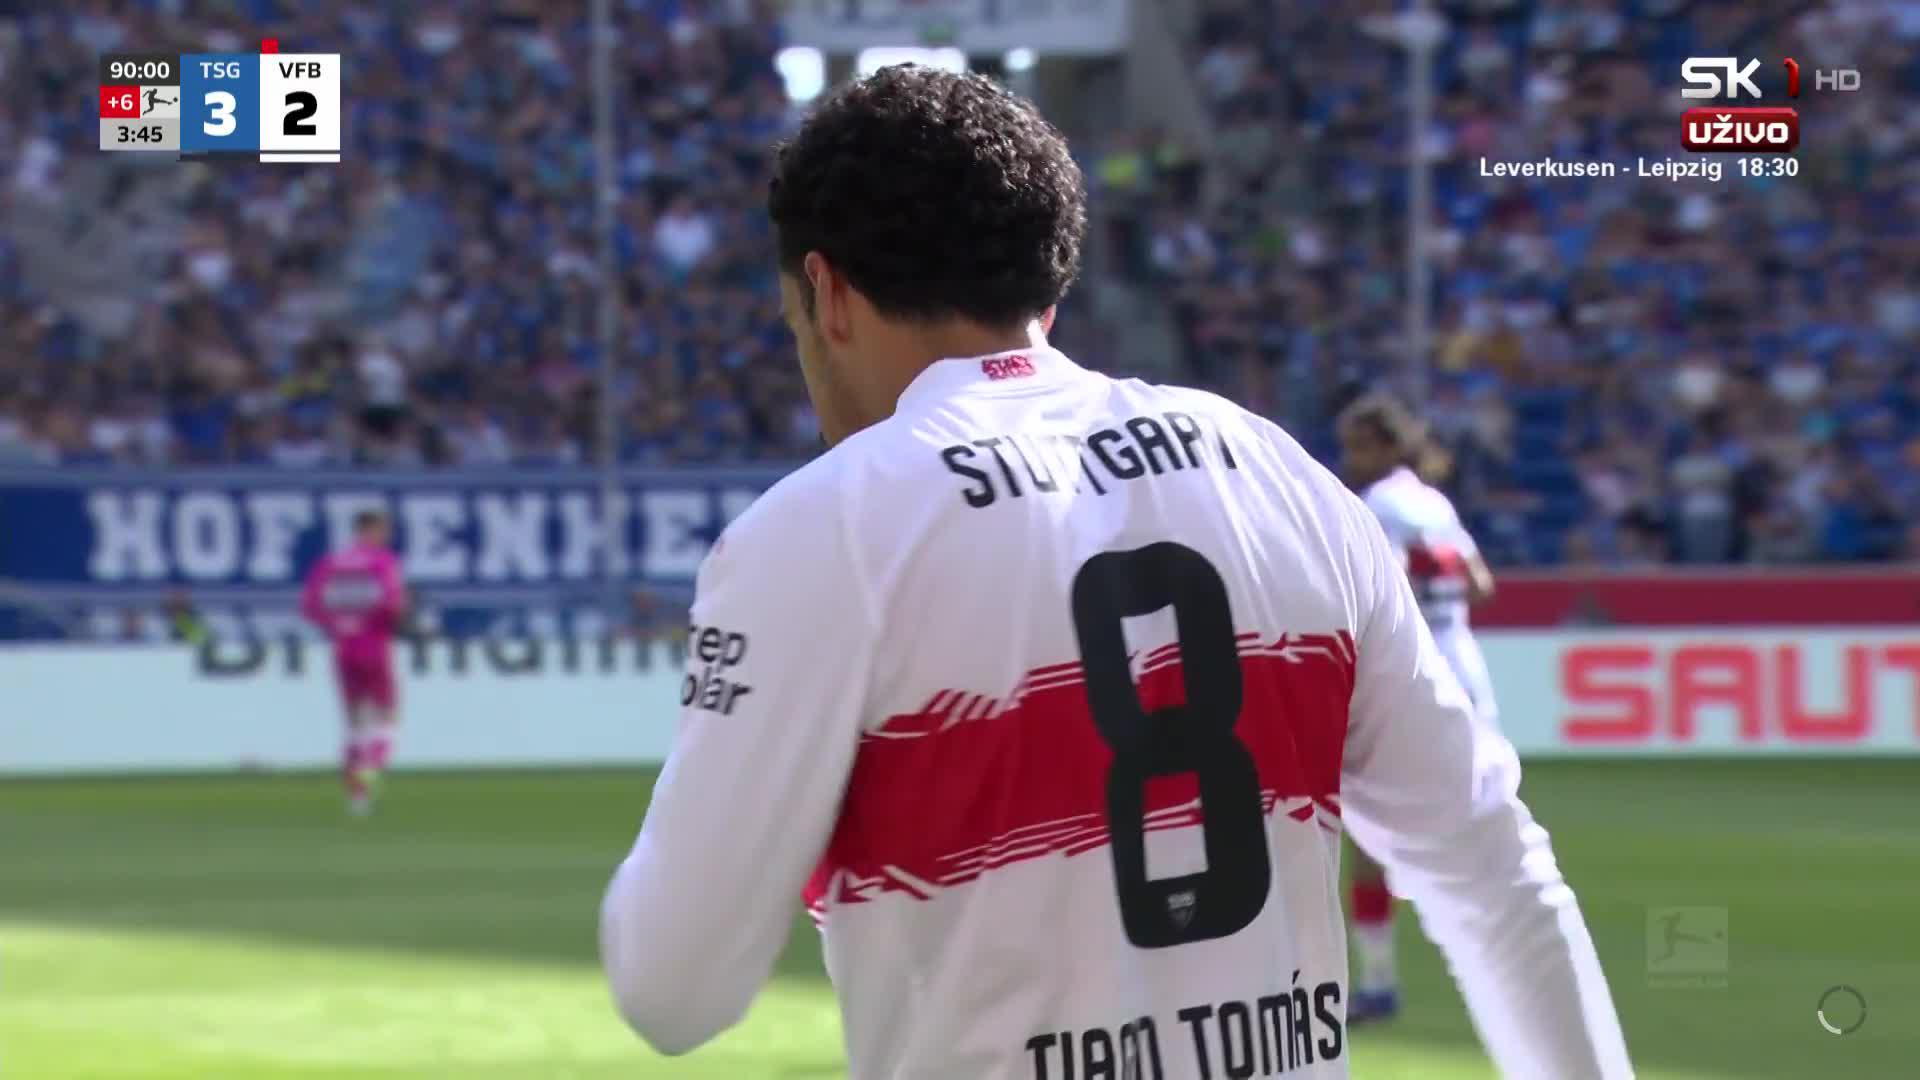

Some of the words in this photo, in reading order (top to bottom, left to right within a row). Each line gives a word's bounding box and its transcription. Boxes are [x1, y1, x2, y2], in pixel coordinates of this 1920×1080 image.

[941, 411, 1238, 509] STUTGAR
[1071, 541, 1271, 949] 8
[1176, 969, 1344, 1080] TOMÁS
